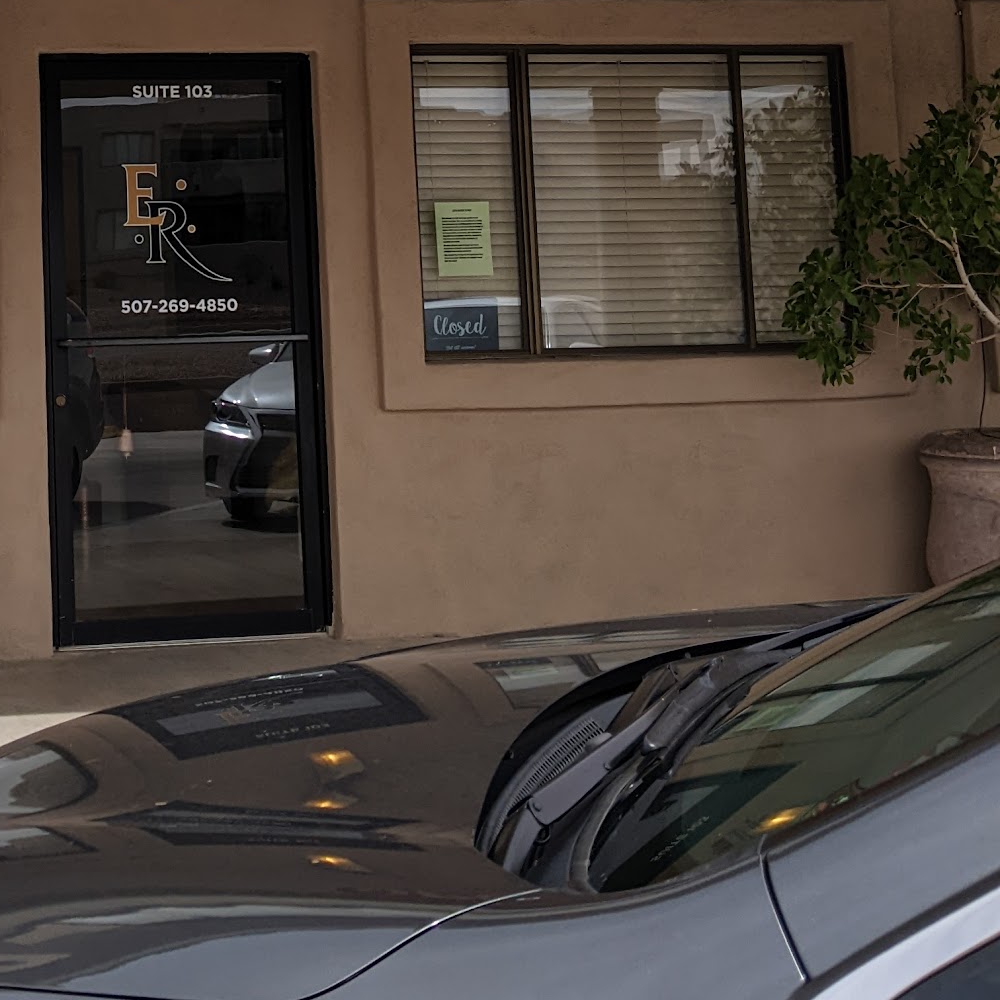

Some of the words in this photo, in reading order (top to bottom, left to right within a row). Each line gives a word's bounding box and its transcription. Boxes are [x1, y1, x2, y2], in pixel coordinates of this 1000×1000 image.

[132, 85, 180, 98] SUITE
[185, 85, 213, 98] 103
[121, 298, 239, 314] 507-269-4850
[433, 313, 487, 337] Closed
